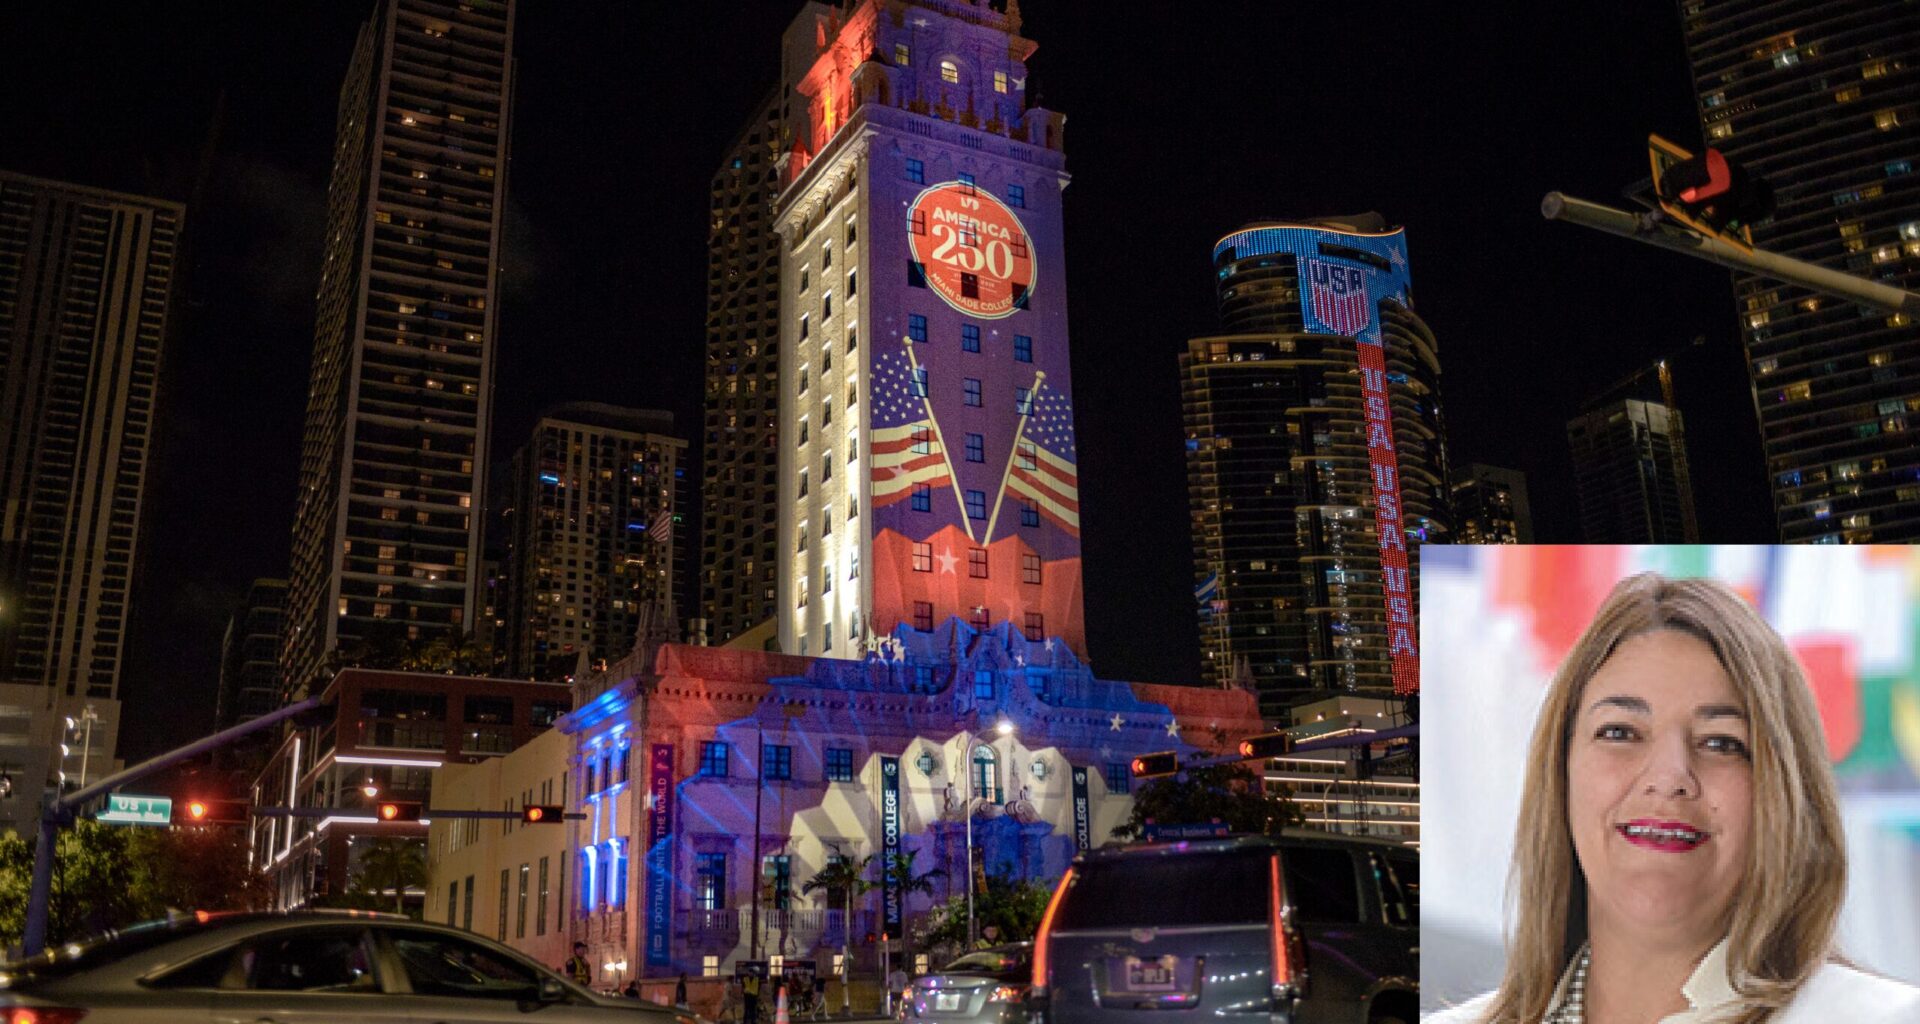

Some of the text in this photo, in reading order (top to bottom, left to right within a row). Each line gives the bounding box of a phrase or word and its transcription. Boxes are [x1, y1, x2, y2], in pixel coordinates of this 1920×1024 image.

[932, 207, 1011, 240] AMERICA
[931, 224, 1014, 279] 250
[930, 273, 954, 298] MIAMI
[955, 294, 979, 310] DADE
[1311, 263, 1363, 294] USA
[1362, 368, 1416, 656] USA USA USA
[118, 799, 139, 811] US
[657, 778, 667, 814] WORLD
[657, 816, 666, 835] THE
[885, 790, 897, 846] COLLEGE
[1076, 798, 1088, 849] COLLEGE
[656, 838, 666, 873] UNITES
[654, 879, 665, 929] FOOTBALL
[887, 886, 898, 923] MIAM
